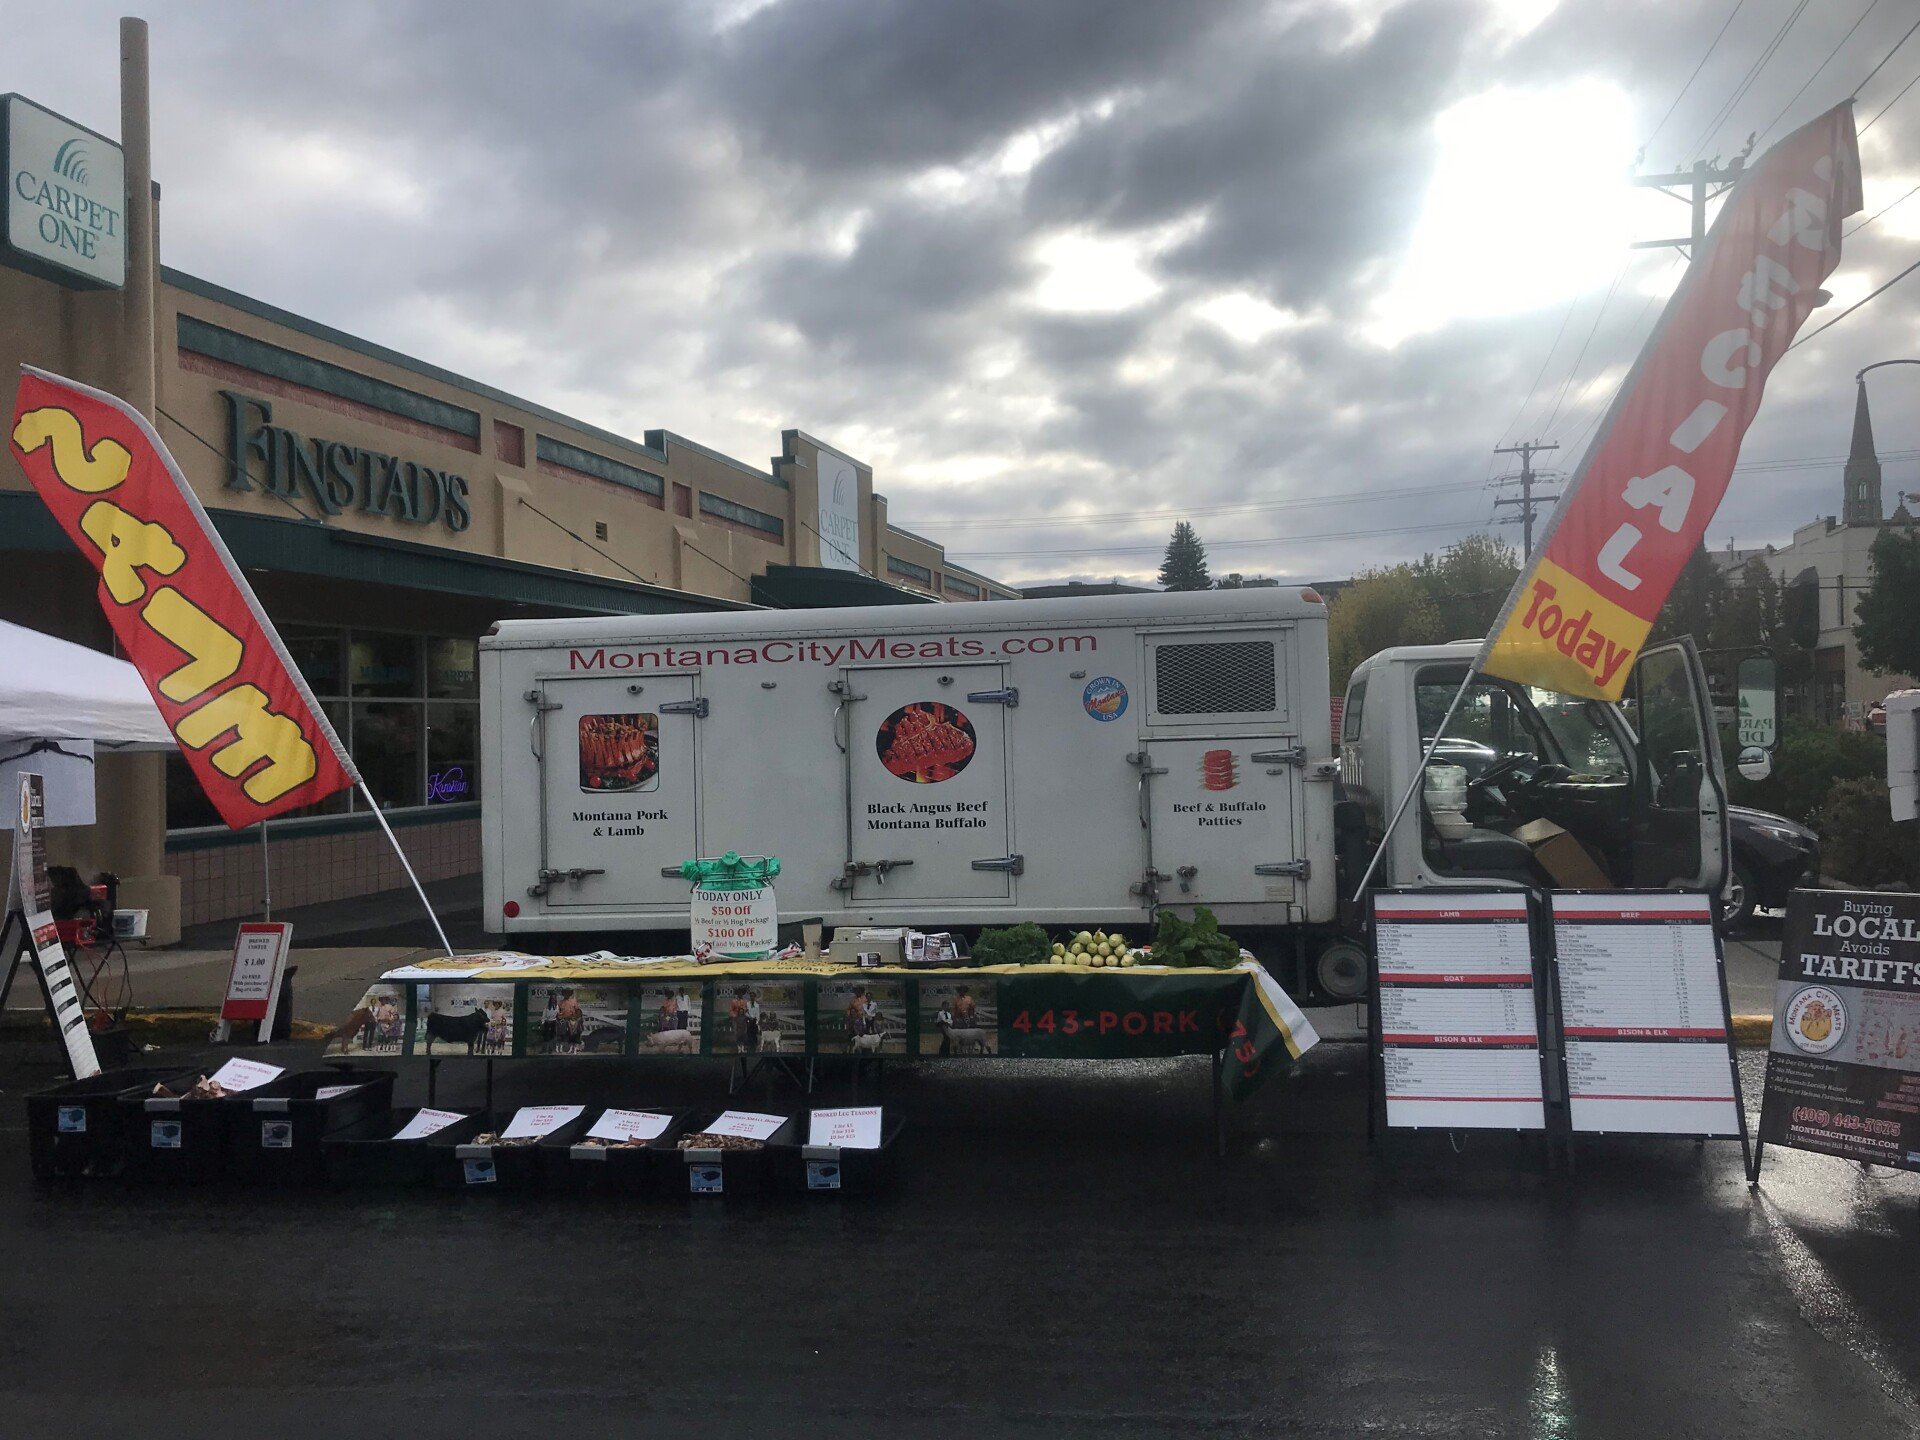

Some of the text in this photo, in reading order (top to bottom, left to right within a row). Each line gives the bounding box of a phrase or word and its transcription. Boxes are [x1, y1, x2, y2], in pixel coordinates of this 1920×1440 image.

[15, 170, 119, 238] CARPET
[38, 213, 97, 260] ONE
[218, 389, 471, 532] FINSTAD'S
[820, 508, 858, 544] CARPET
[829, 539, 850, 566] ONE
[1521, 579, 1632, 686] Today
[569, 634, 1097, 670] MontanaCityMeats.com
[1086, 677, 1111, 696] GROWN
[1083, 688, 1127, 711] Montana
[1102, 712, 1118, 721] USA
[572, 809, 668, 822] Montana Pork
[867, 801, 989, 815] Black Angus Beef
[1173, 801, 1266, 813] Beef & Buffalo
[867, 817, 987, 830] Montana Buffalo
[1198, 816, 1242, 826] Patties
[592, 825, 644, 836] & Lamb
[696, 890, 763, 902] TODAY ONLY
[711, 904, 752, 916] $50 Off
[1843, 900, 1894, 916] Buying
[730, 918, 744, 927] Hog
[1813, 914, 1920, 942] LOCAL
[707, 927, 755, 938] $100 Off
[1840, 940, 1890, 956] Avoids
[1788, 994, 1812, 1025] MONTANA
[1832, 1004, 1841, 1031] MEATS
[1013, 1008, 1198, 1036] 443-PORK
[1792, 1106, 1901, 1136] (406) 443-7675
[1790, 1124, 1899, 1149] MONTANACITYMEATS.COM
[1858, 1146, 1886, 1157] Montana
